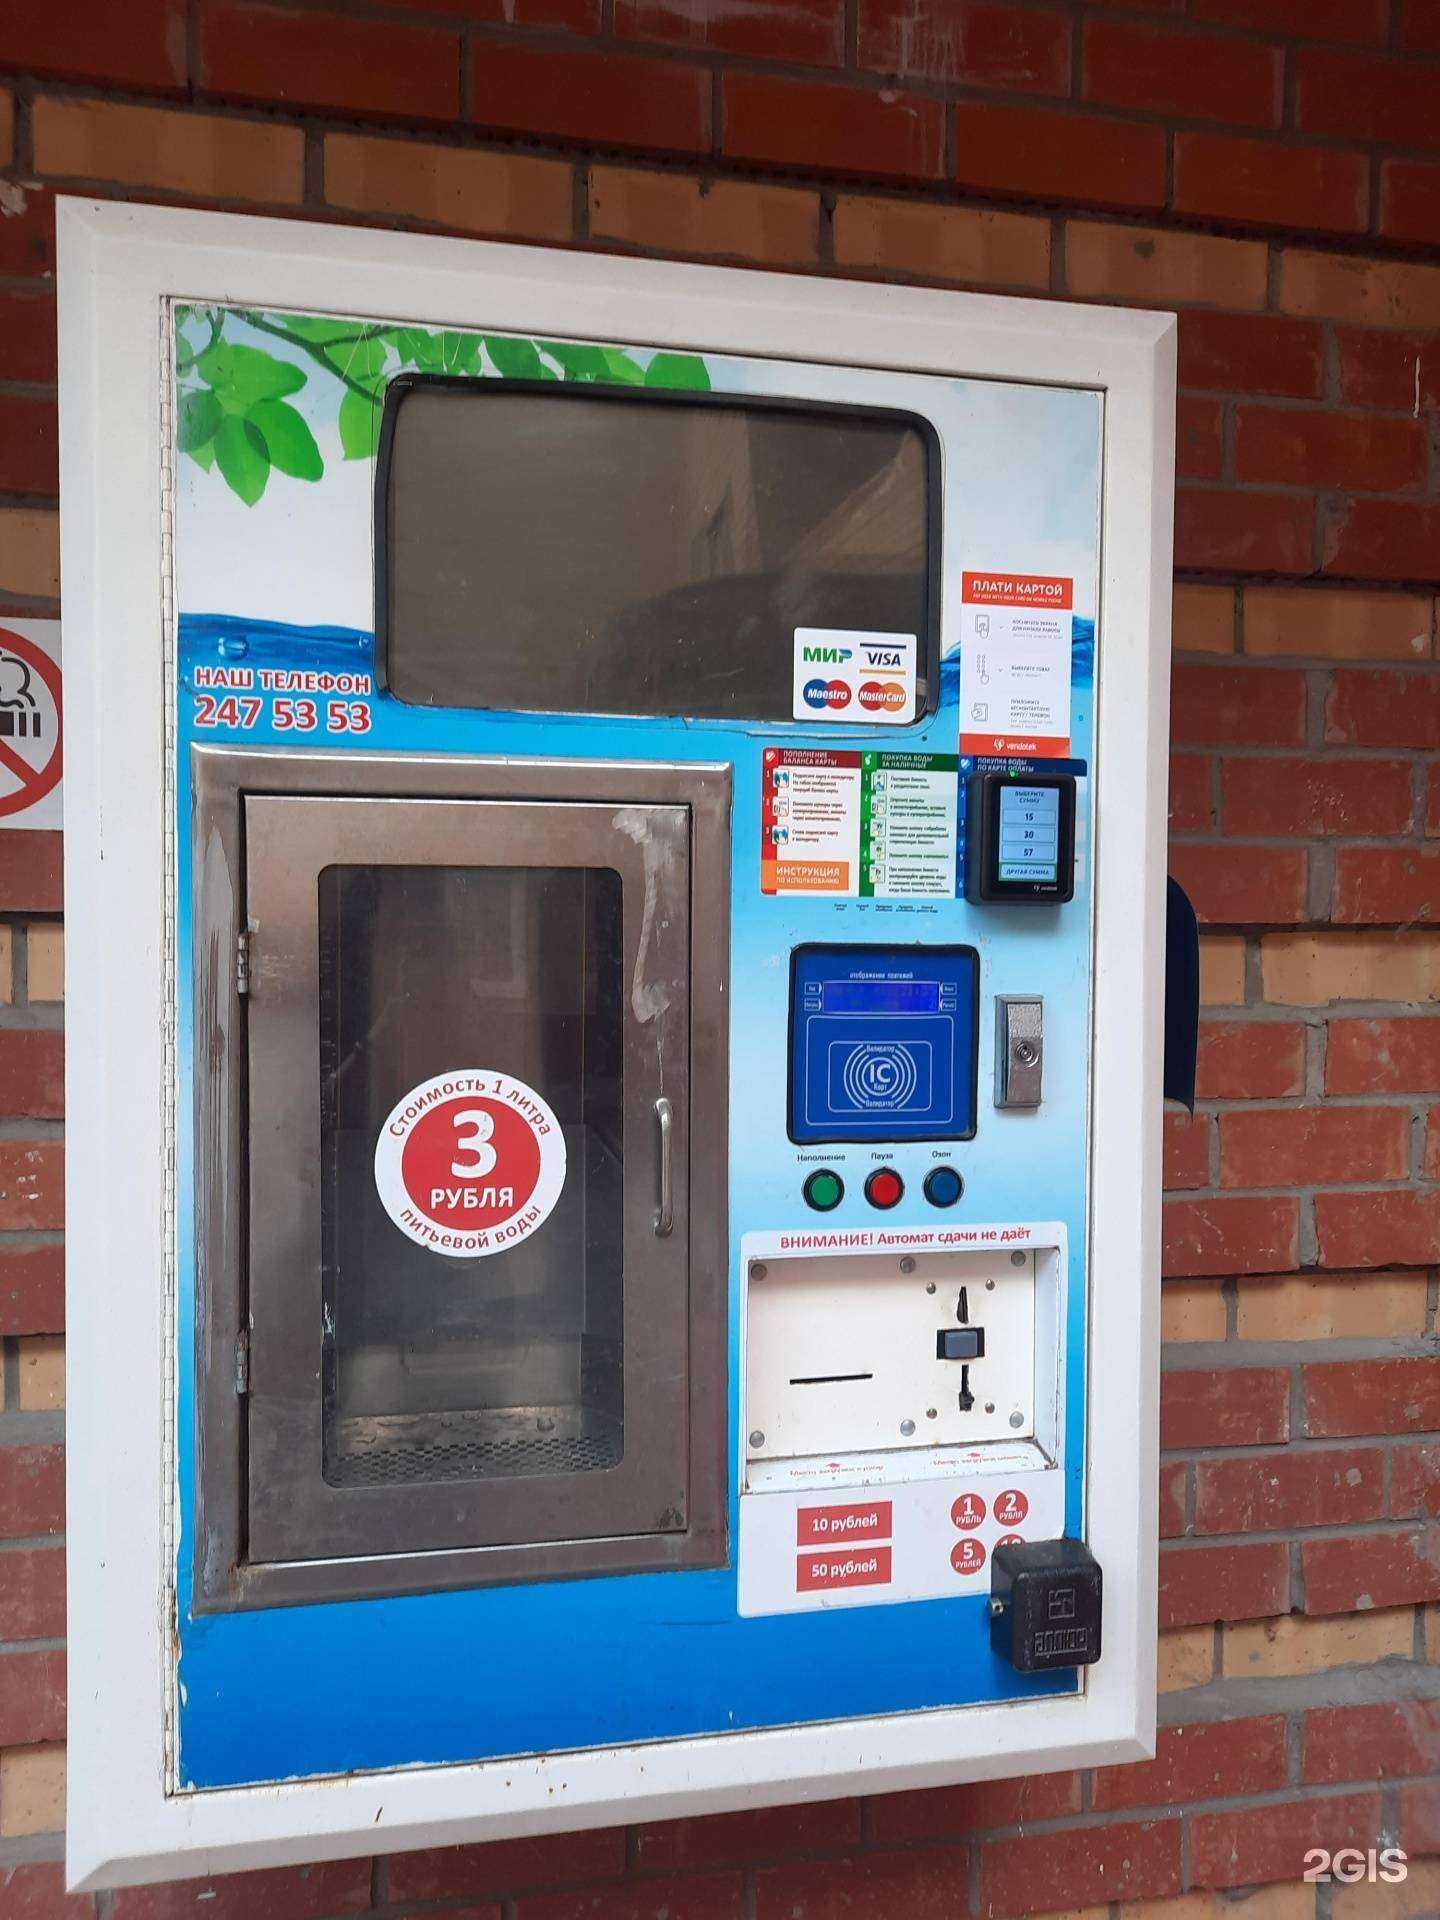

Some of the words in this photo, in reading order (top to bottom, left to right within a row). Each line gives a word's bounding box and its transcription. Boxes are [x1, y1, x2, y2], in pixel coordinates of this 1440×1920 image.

[973, 580, 1012, 593] ПЛАТИ
[1016, 581, 1062, 595] КАРТОЙ
[803, 647, 852, 663] МИР
[867, 652, 901, 666] VISA
[195, 668, 252, 687] НАШ
[259, 671, 370, 694] ТЕЛЕФОН
[807, 688, 848, 700] Maestro
[860, 691, 906, 702] MasterCard
[195, 696, 262, 727] 247
[273, 700, 317, 729] 53
[328, 703, 371, 732] 53
[1006, 741, 1037, 751] vendotek
[783, 750, 828, 758] ПОПОЛНЕНИЕ
[913, 755, 933, 763] ВОДЫ
[1008, 758, 1027, 766] ВОДЫ
[1025, 813, 1034, 821] 15
[1024, 830, 1034, 839] 30
[1024, 848, 1033, 856] 57
[776, 866, 840, 877] ИНСТРУКЦИЯ
[1006, 868, 1028, 876] ДРУГАЯ
[869, 1064, 891, 1083] IC
[389, 1079, 486, 1137] Стоимость
[492, 1080, 503, 1095] 1
[506, 1090, 551, 1136] литра
[451, 1109, 498, 1179] 3
[797, 1153, 846, 1162] Наполнение
[871, 1152, 894, 1161] Пауза
[931, 1150, 951, 1159] Озон
[430, 1186, 514, 1209] РУБЛЯ
[400, 1209, 489, 1249] питьевой
[494, 1205, 542, 1244] воды
[780, 1233, 874, 1249] ВНИМАНИЕ!
[877, 1232, 935, 1245] Автомат
[938, 1231, 977, 1244] сдачи
[980, 1231, 997, 1241] не
[1000, 1227, 1032, 1243] даёт
[964, 1497, 974, 1515] 1
[1005, 1493, 1017, 1512] 2
[956, 1513, 982, 1524] РУБЛЬ
[999, 1510, 1023, 1521] РУБЛЯ
[812, 1518, 829, 1532] 10
[831, 1512, 878, 1533] рублей
[963, 1542, 974, 1559] 5
[811, 1564, 828, 1577] 50
[831, 1558, 878, 1578] рублей
[955, 1558, 982, 1568] РУБЛЕЙ
